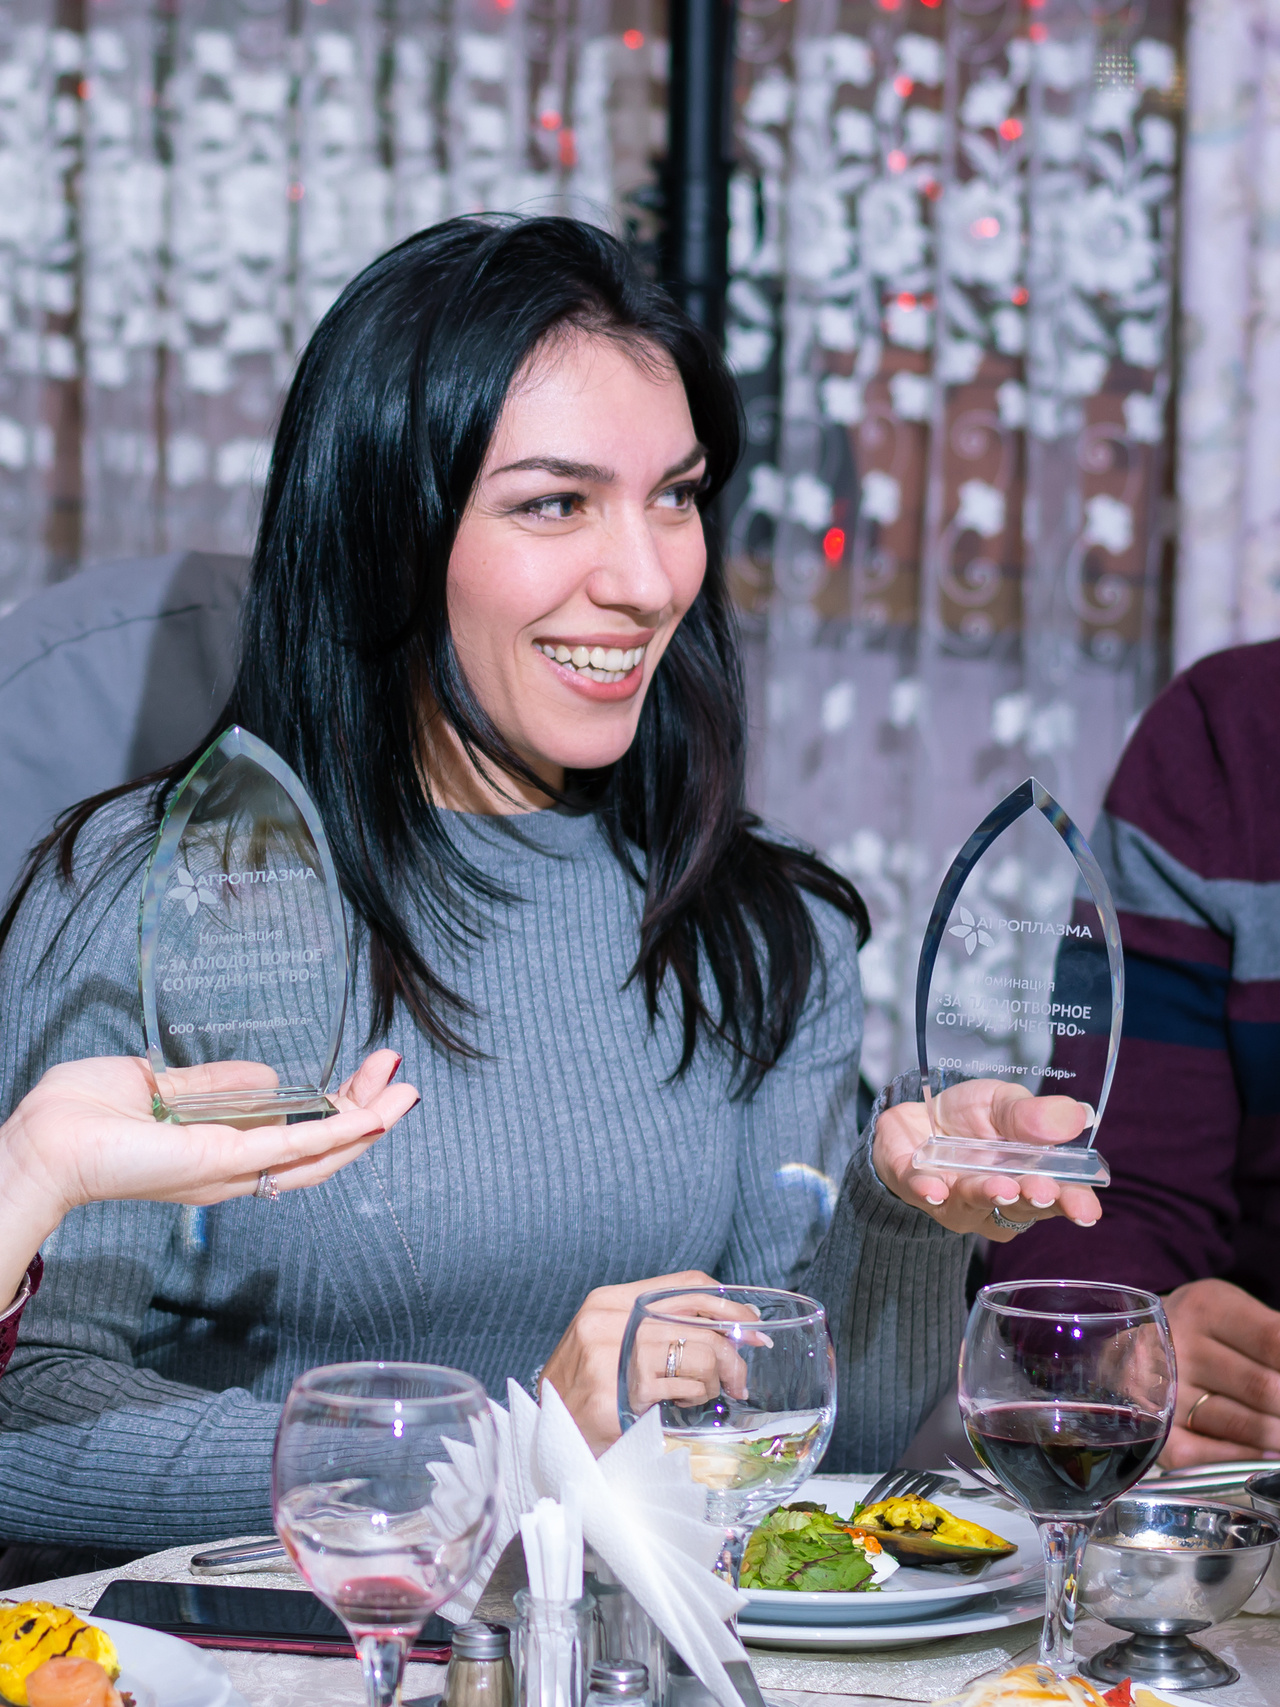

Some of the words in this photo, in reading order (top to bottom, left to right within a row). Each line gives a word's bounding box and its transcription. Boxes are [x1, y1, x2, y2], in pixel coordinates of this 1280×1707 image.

[196, 867, 317, 887] АГРОПЛАЗМА
[198, 930, 283, 945] Номинация
[976, 917, 1093, 938] АГРОПЛАЗМА
[193, 948, 323, 970] ПЛОДОТВОРНОЕ
[162, 968, 318, 992] СОТРУДНИЧЕСТВО»
[974, 975, 1055, 992] оминация
[168, 1024, 195, 1035] ООО
[198, 1016, 313, 1033] «АгроГибридВолга»
[938, 1057, 962, 1069] ООО
[966, 1060, 1029, 1076] «Приоритет
[1031, 1066, 1076, 1080] Сибирь»
